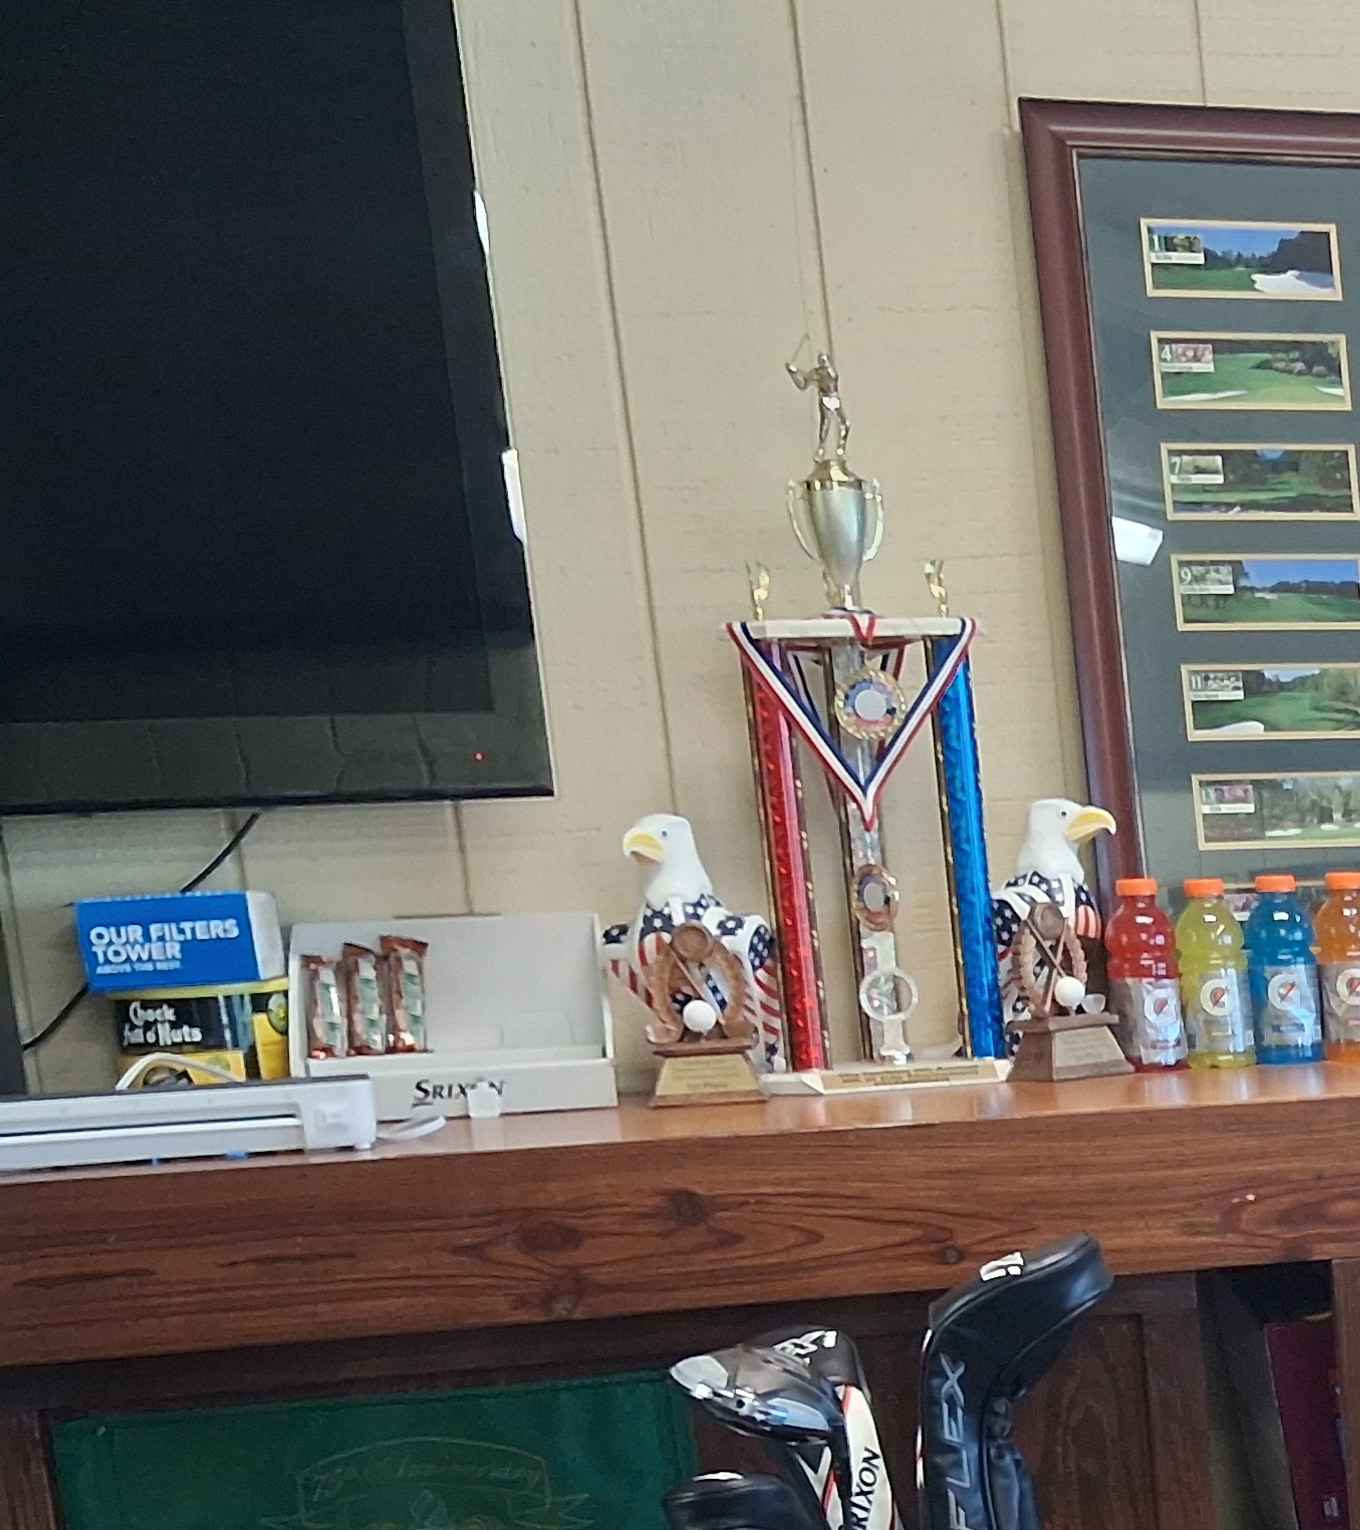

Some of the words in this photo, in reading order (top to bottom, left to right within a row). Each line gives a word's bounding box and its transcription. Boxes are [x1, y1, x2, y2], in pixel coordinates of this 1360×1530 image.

[89, 923, 144, 946] OUR
[149, 918, 240, 943] FILTERS
[91, 941, 183, 965] TOWER
[412, 1078, 506, 1106] SRIXN
